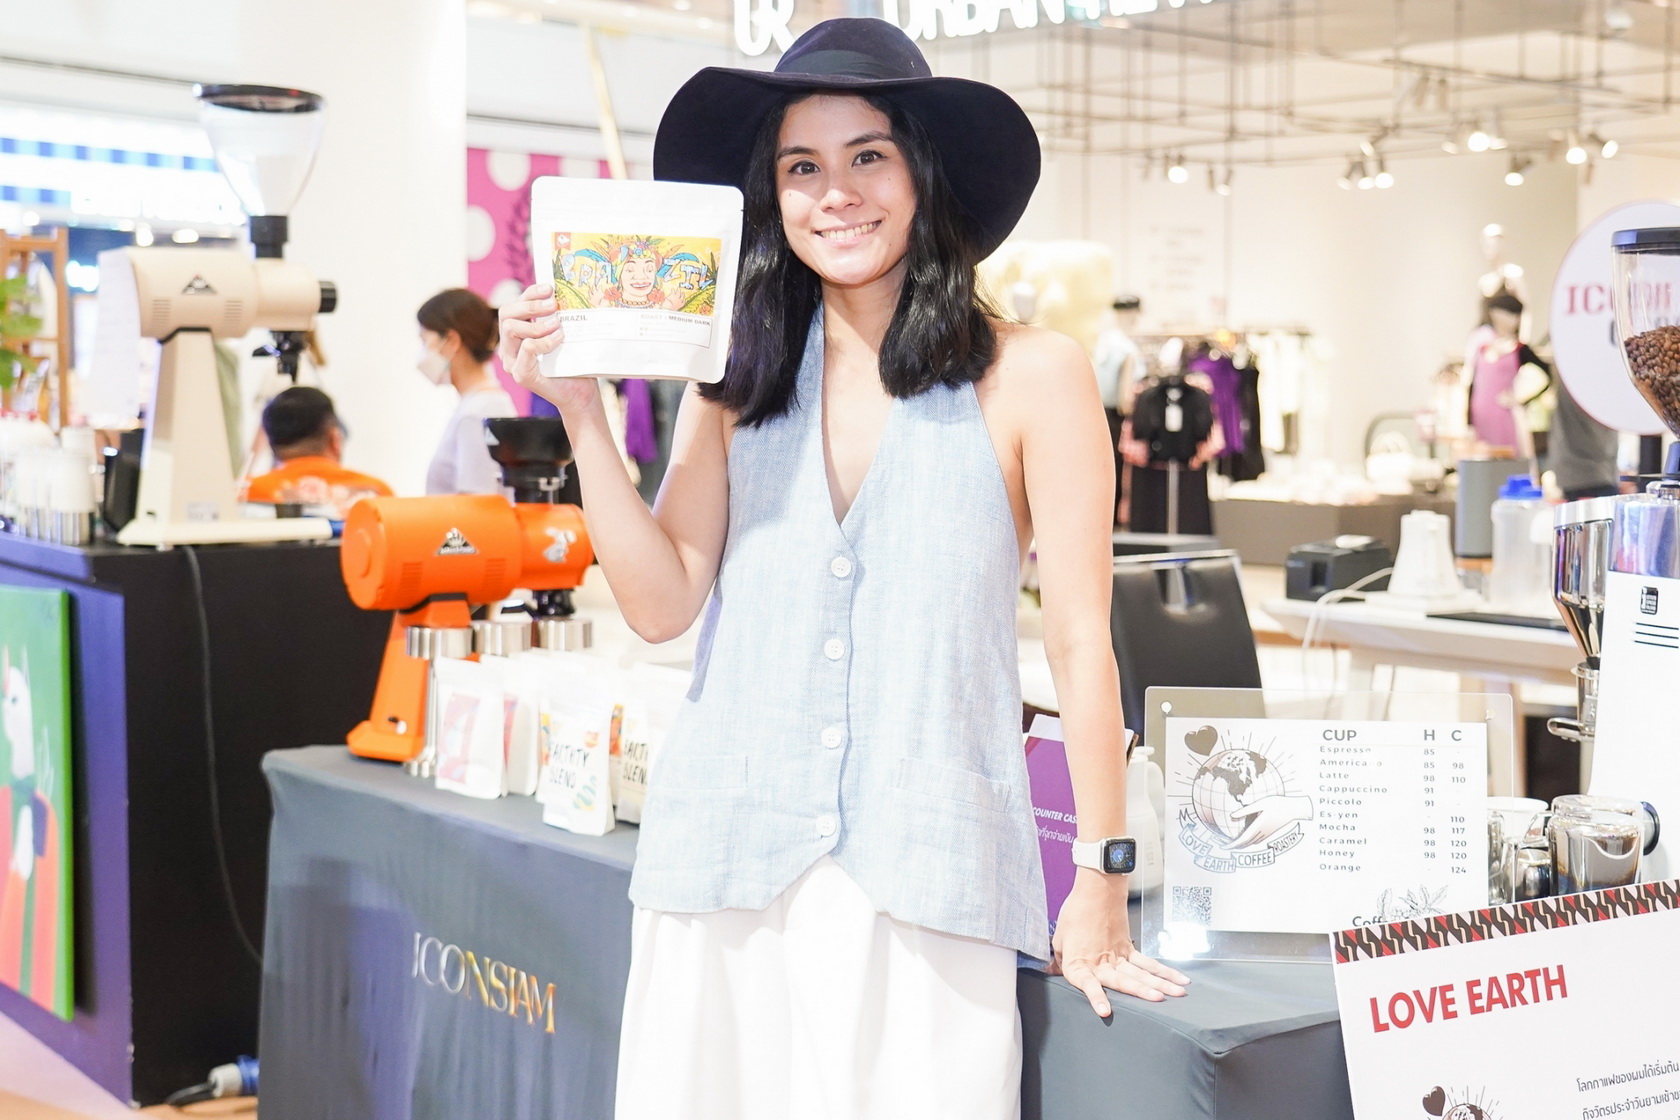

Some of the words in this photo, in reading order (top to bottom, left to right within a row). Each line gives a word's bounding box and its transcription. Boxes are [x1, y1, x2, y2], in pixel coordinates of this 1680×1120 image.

[668, 315, 693, 323] MEDIUM
[1322, 729, 1357, 742] CUP
[1424, 729, 1435, 741] H
[1451, 729, 1462, 742] C
[1319, 745, 1371, 755] Espresso
[1423, 748, 1435, 756] 85
[1319, 758, 1382, 767] Americao
[1423, 761, 1435, 769] 85
[1319, 771, 1349, 779] Latte
[1319, 784, 1388, 794] Cappuccino
[1319, 798, 1362, 806] Piccolo
[1319, 823, 1356, 831] Mocha
[1319, 837, 1367, 845] Caramel
[1424, 839, 1436, 847] 98
[1183, 833, 1208, 856] LOVE
[1203, 856, 1235, 872] EARTH
[1237, 852, 1273, 867] COFFEE
[1273, 831, 1300, 853] ROASTERY
[1319, 849, 1355, 858] Honey
[1450, 852, 1467, 860] 120
[1319, 863, 1361, 872] Orange
[1451, 866, 1466, 874] 124
[1352, 915, 1389, 928] Coff
[411, 931, 557, 1035] ICONSIAM
[1369, 983, 1458, 1033] LOVE
[1465, 964, 1568, 1015] EARTH
[1582, 1089, 1680, 1120] กิจวัตรประจำวันยามเช้าข
